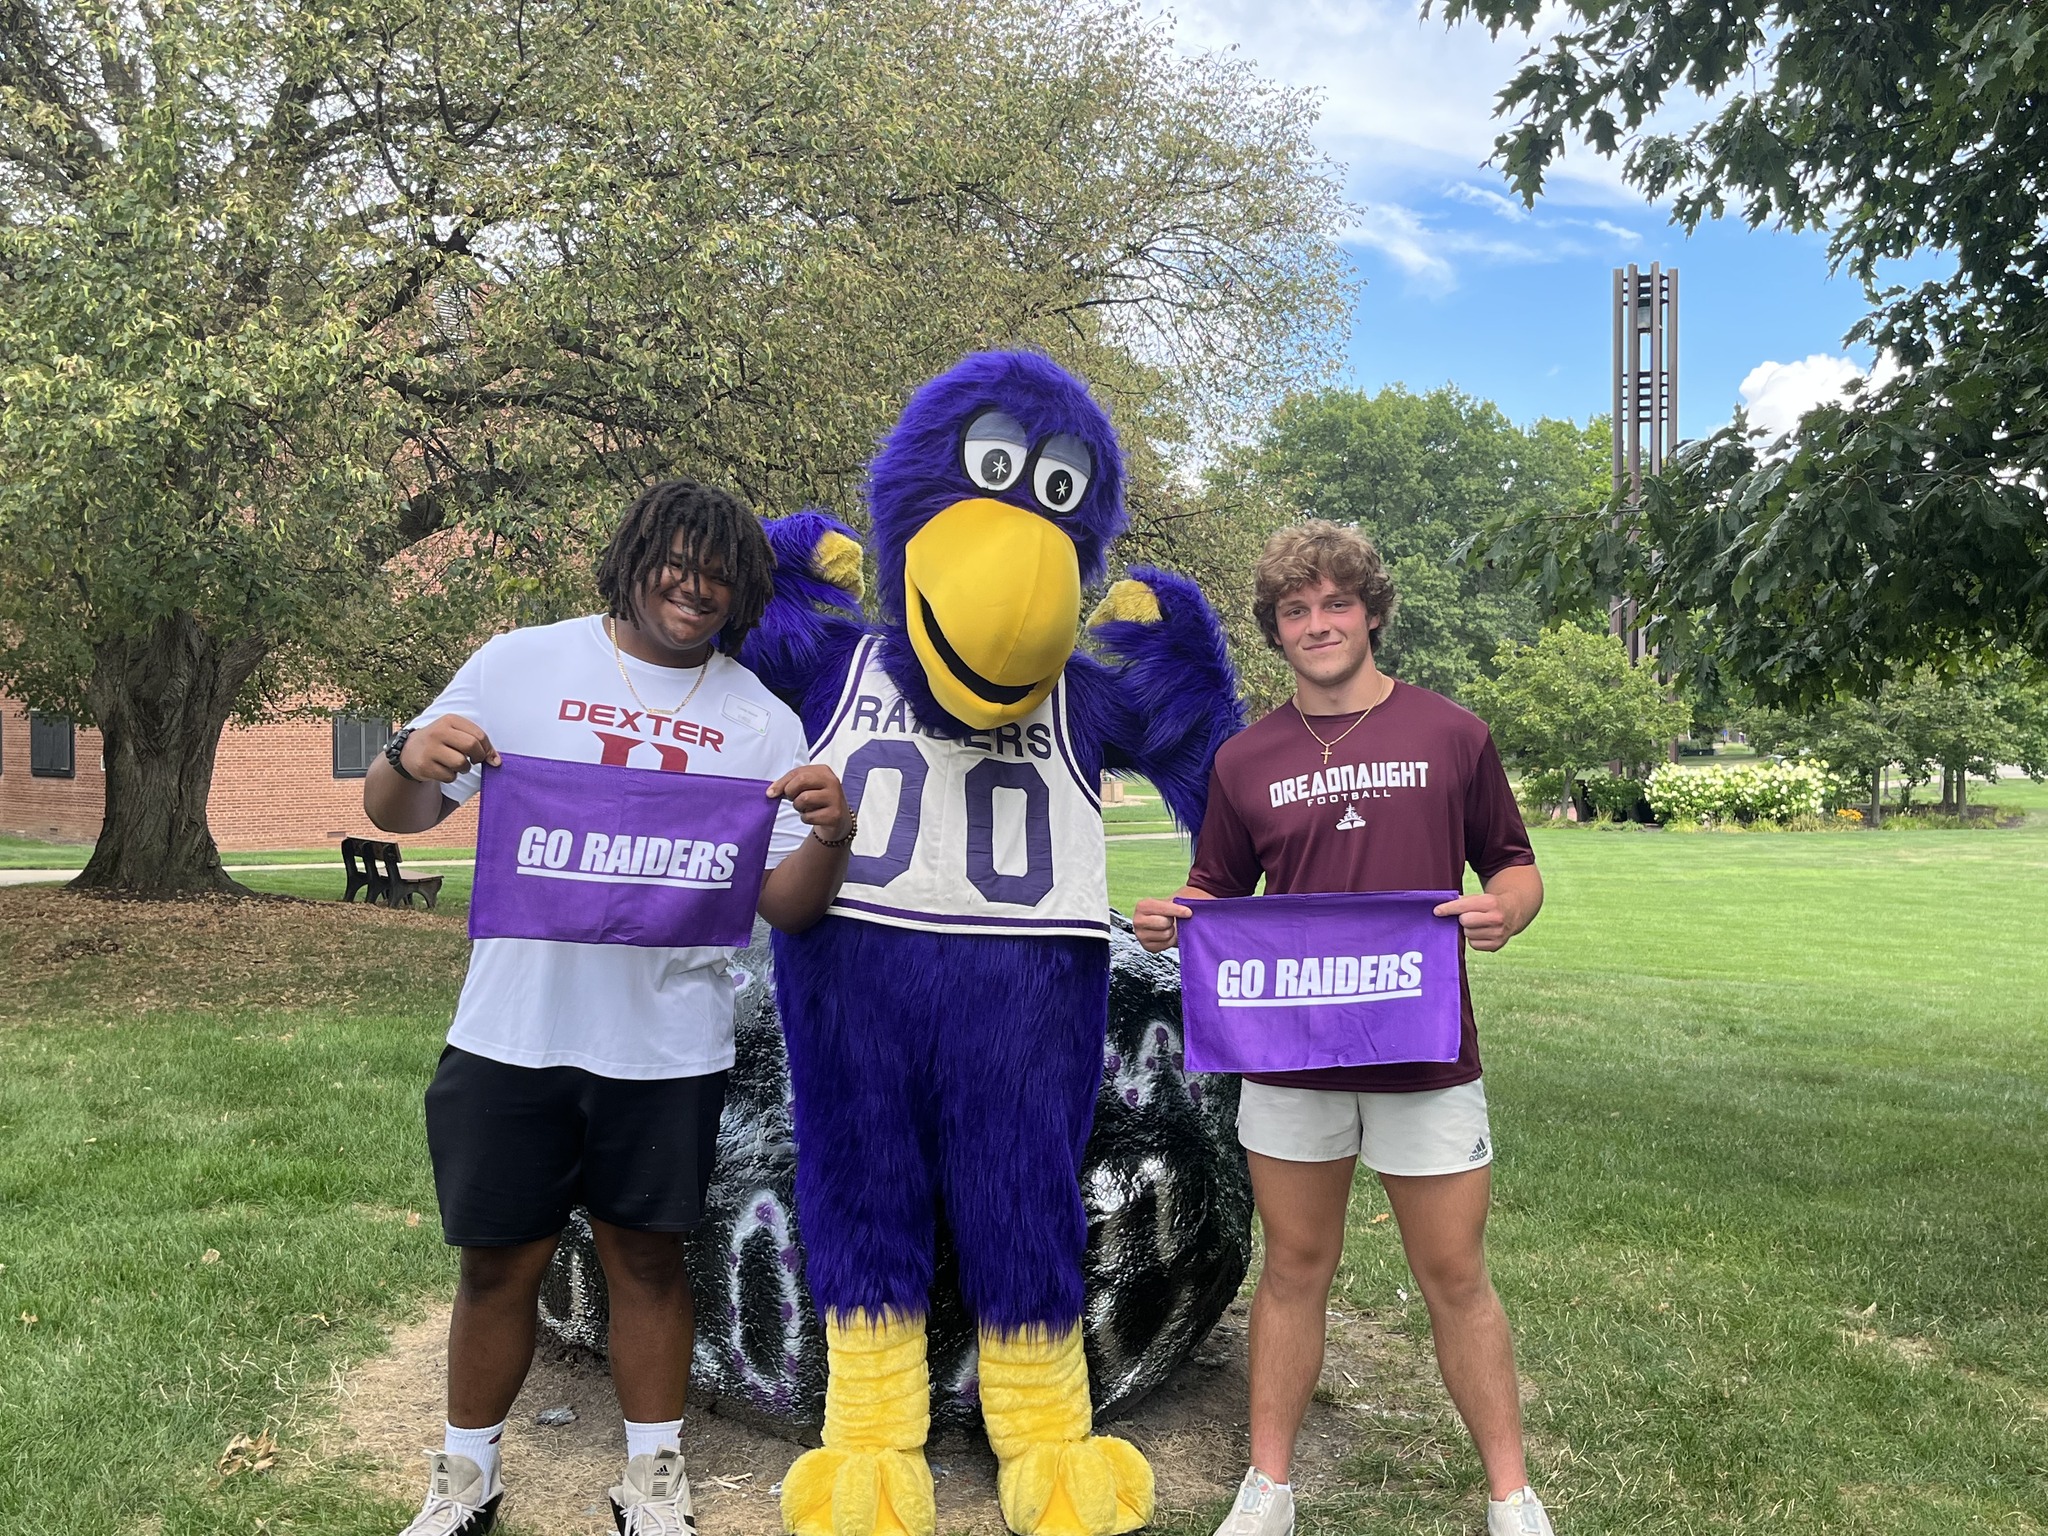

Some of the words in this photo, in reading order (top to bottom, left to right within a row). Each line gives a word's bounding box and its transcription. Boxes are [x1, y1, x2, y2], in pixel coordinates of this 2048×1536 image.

[558, 699, 724, 753] DEXTER
[851, 695, 1052, 760] RAERS
[1269, 761, 1429, 808] DREADNAUGHT
[1307, 789, 1392, 807] FOOTBALL
[841, 738, 1055, 908] 00
[516, 825, 574, 869] GO
[579, 831, 739, 881] RAIDERS
[1216, 959, 1266, 999] GO
[1274, 950, 1424, 998] RAIDERS
[1469, 1149, 1488, 1162] adida
